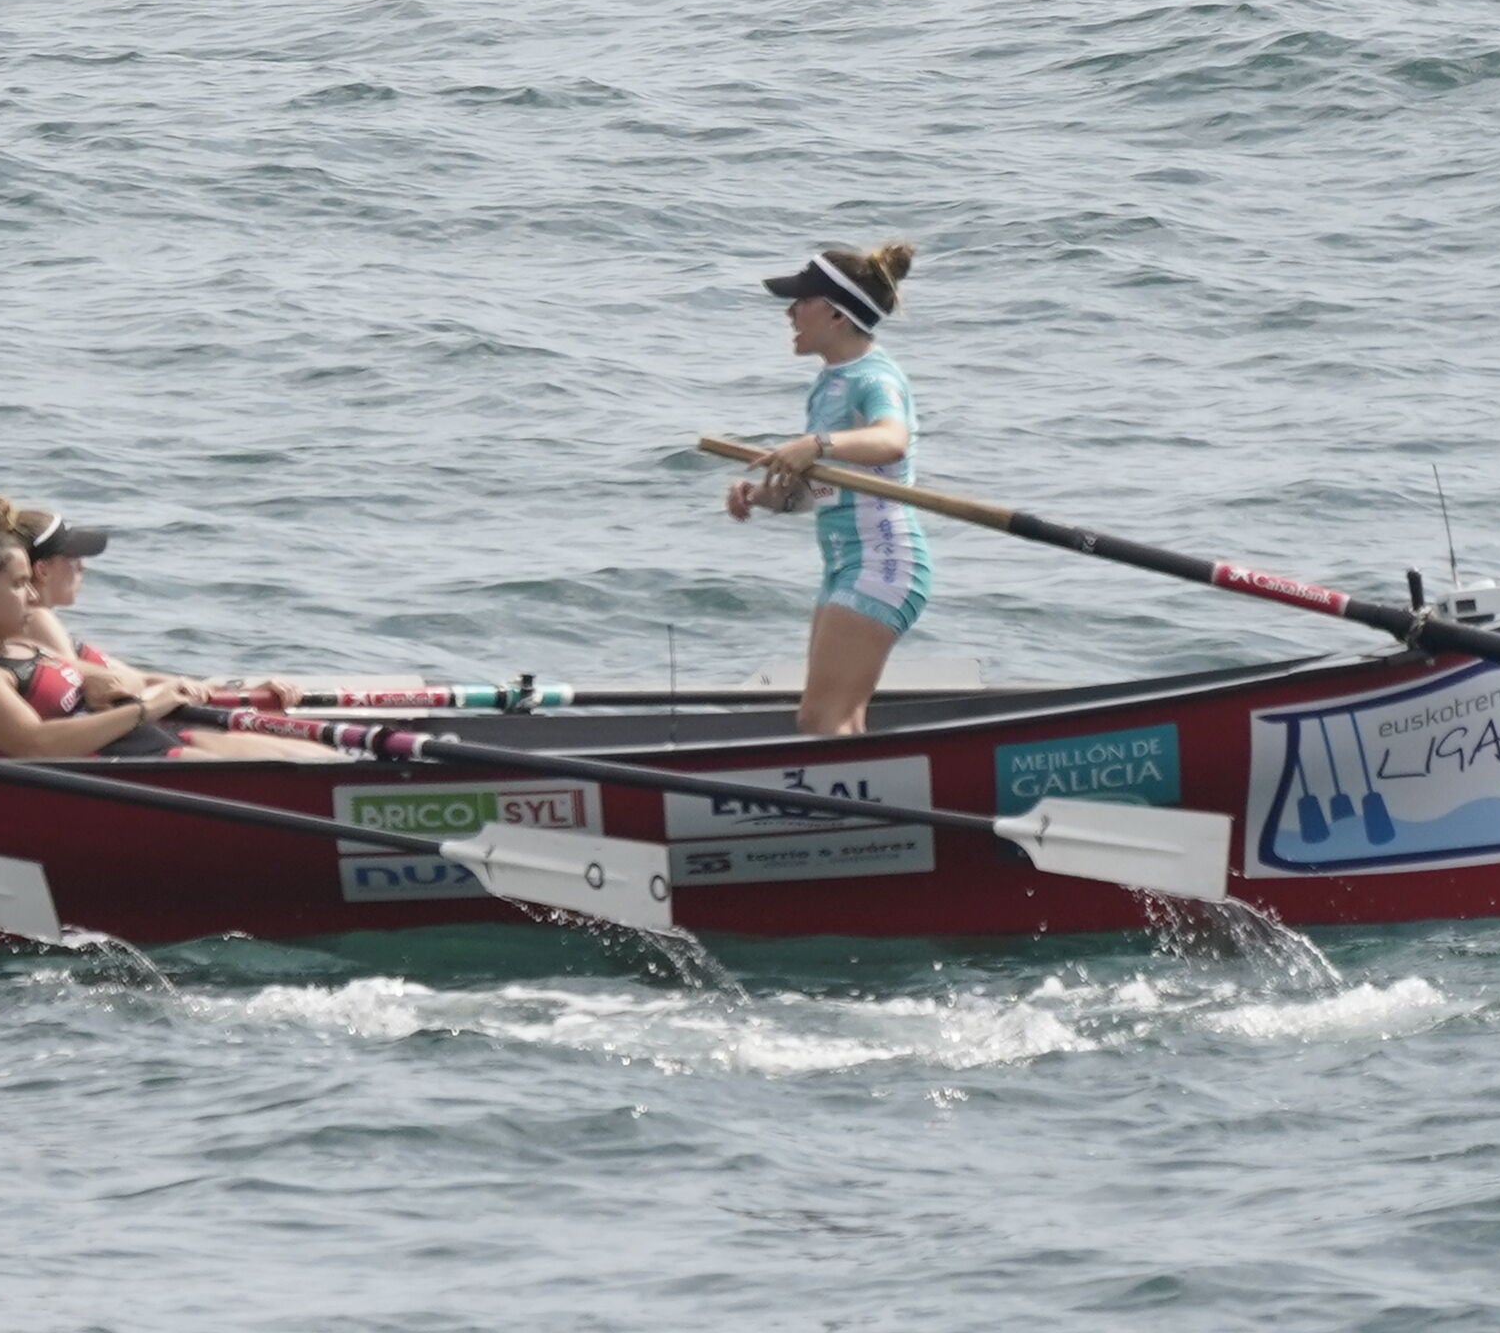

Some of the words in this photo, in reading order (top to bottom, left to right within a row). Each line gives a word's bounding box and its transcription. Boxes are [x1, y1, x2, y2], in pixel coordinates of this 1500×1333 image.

[1011, 740, 1122, 773] MEJILLÓN
[1126, 737, 1162, 758] DE
[1011, 760, 1163, 799] GALICIA
[360, 802, 474, 831] BRICO
[503, 799, 568, 825] SYL
